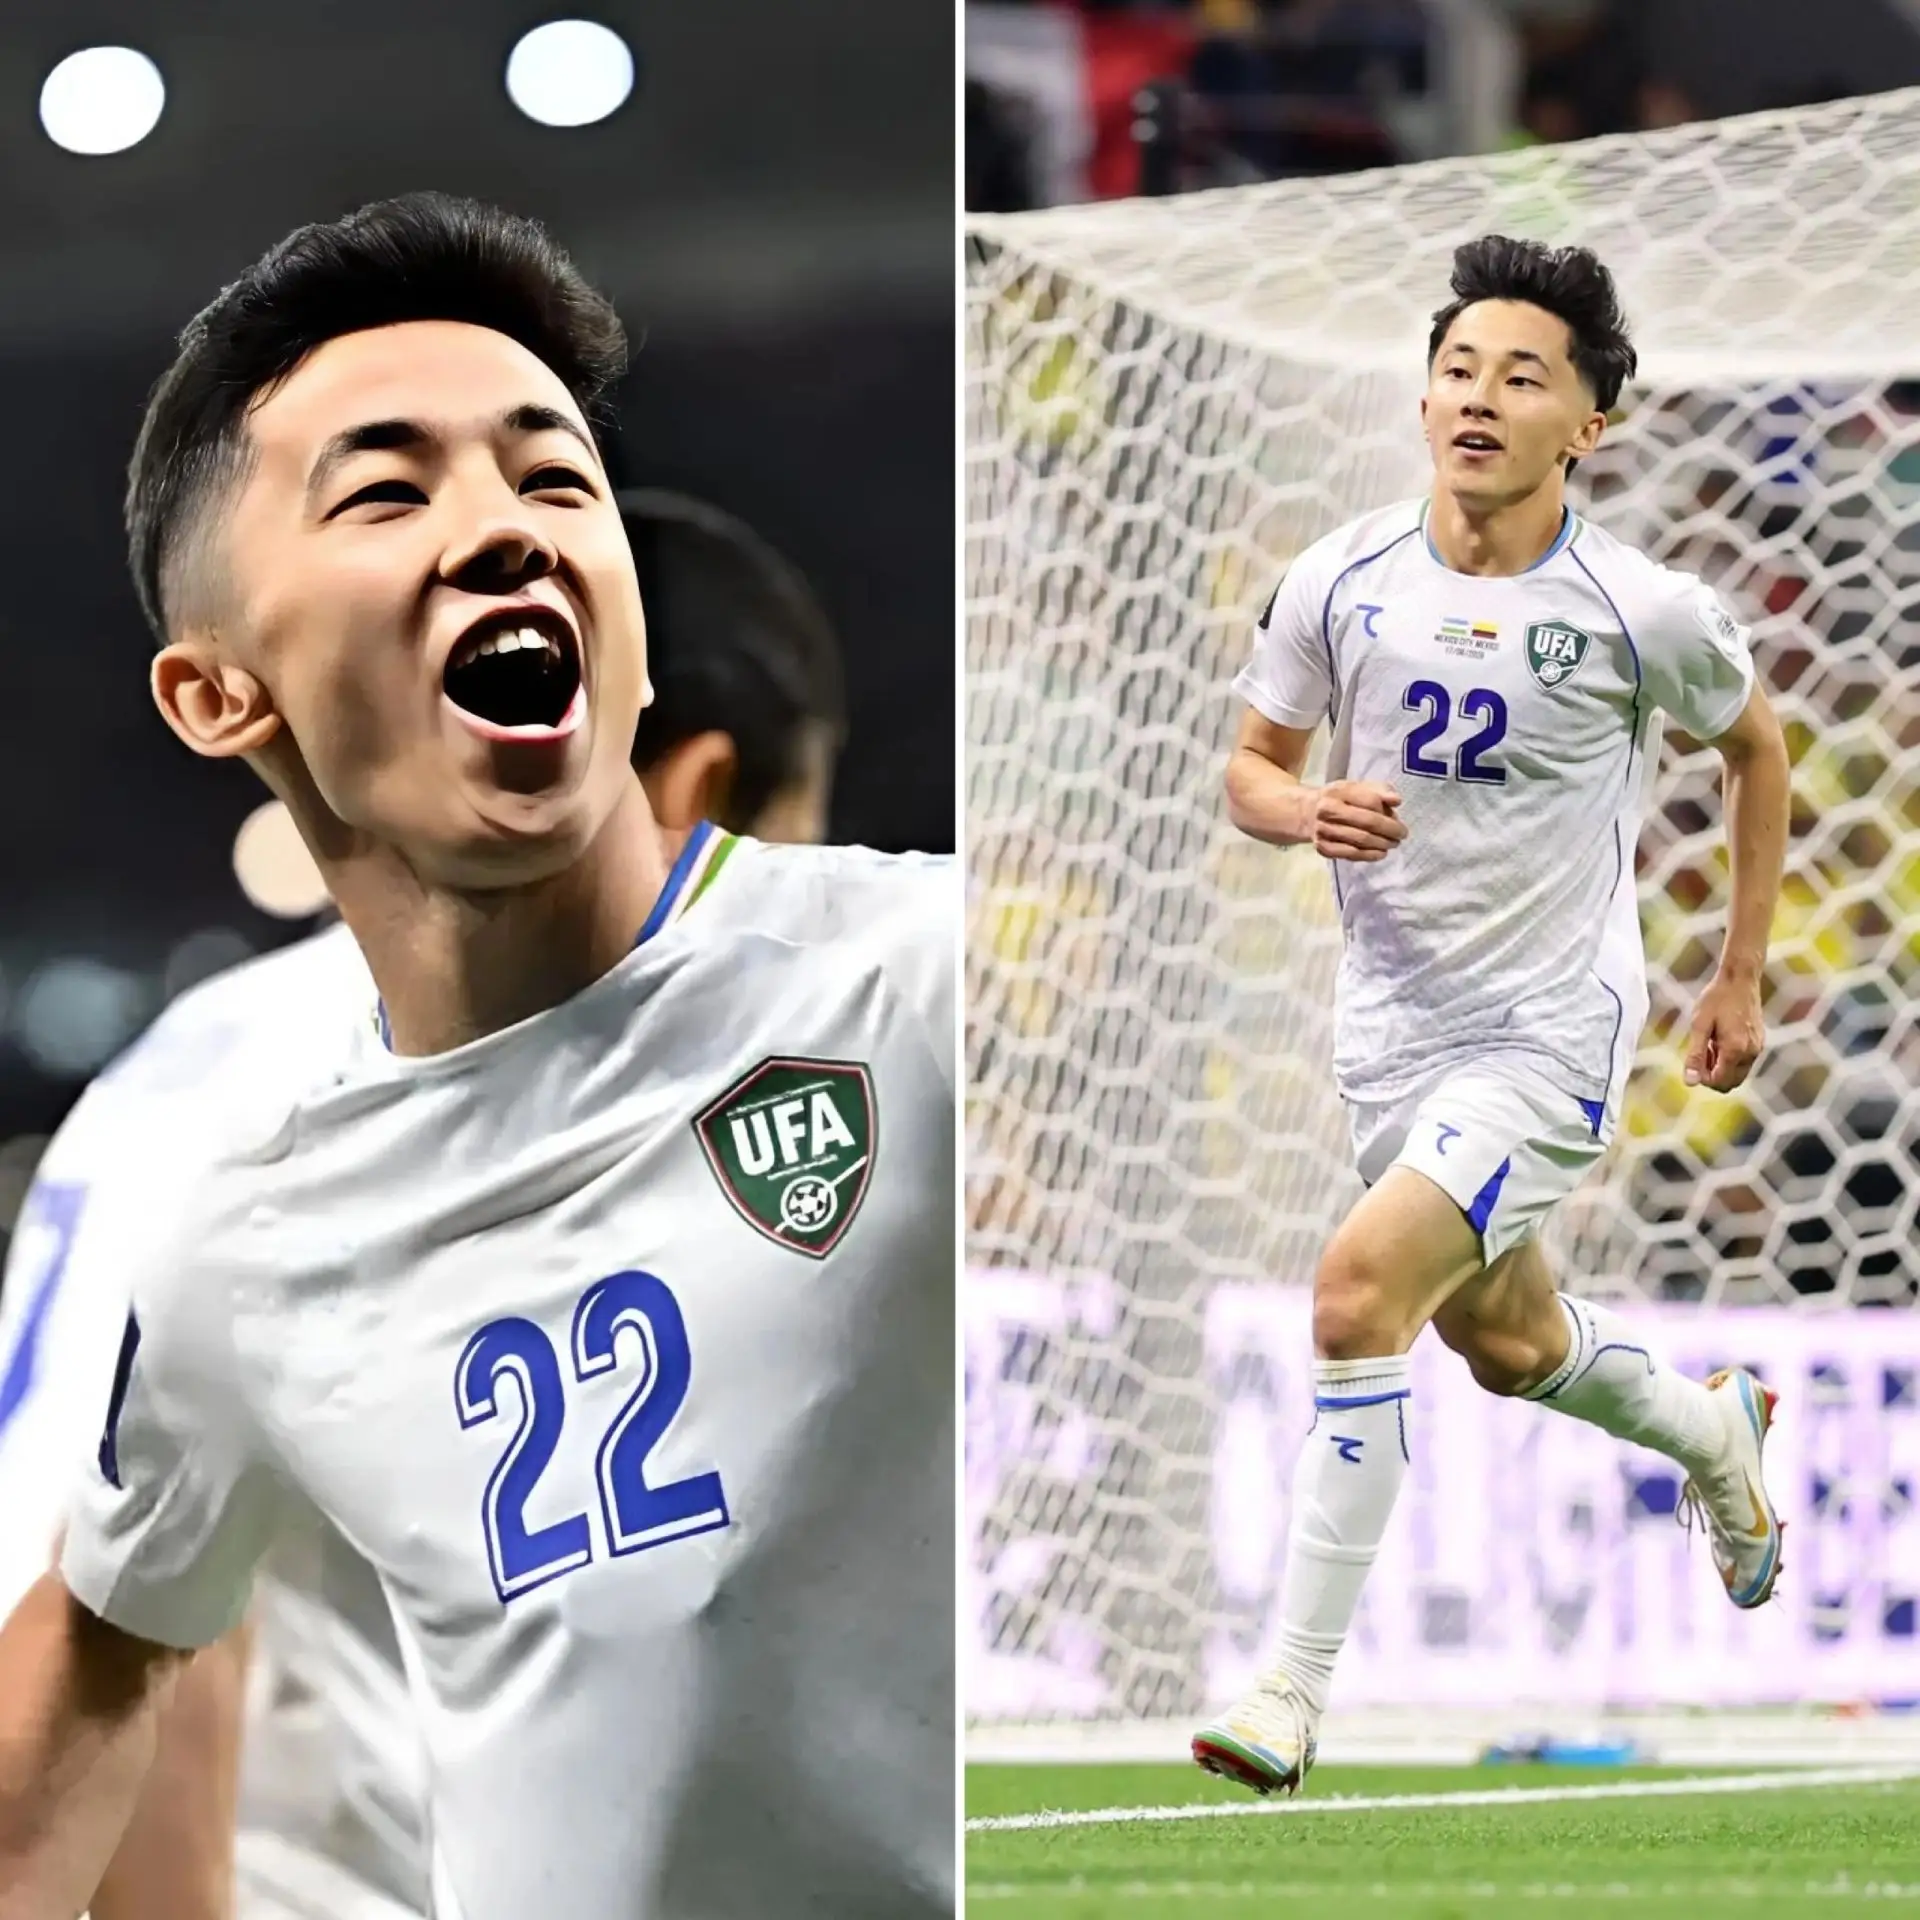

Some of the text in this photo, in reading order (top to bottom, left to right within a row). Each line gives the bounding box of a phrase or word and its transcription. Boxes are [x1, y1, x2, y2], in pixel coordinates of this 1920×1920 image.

[1534, 630, 1577, 660] UFA
[1402, 680, 1507, 785] 22
[730, 1091, 857, 1176] UFA
[454, 1269, 730, 1604] 22
